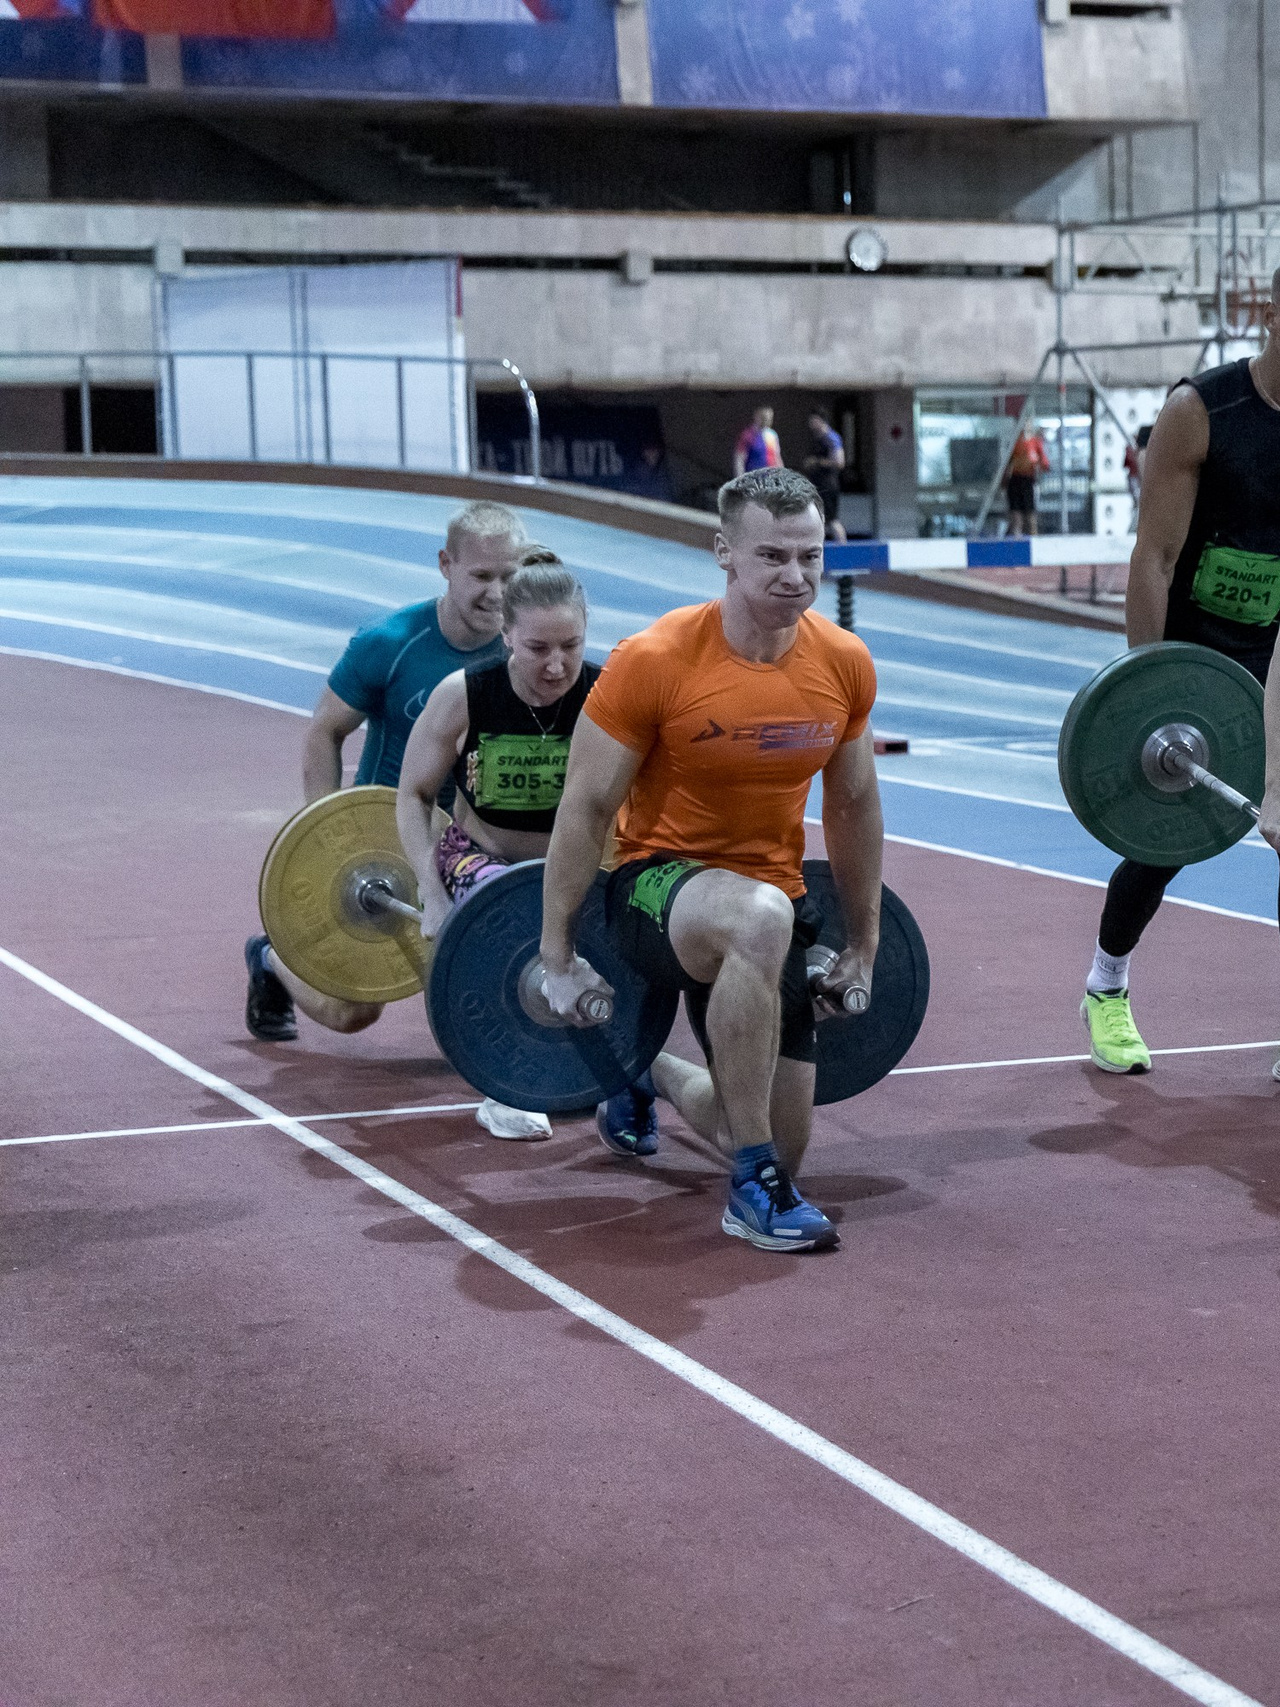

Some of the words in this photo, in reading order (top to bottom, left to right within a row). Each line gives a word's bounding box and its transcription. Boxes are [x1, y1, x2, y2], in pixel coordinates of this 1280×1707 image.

[1214, 565, 1279, 585] STANDART
[1211, 582, 1272, 606] 220-1
[497, 755, 569, 767] STANDART
[497, 773, 566, 790] 305-3
